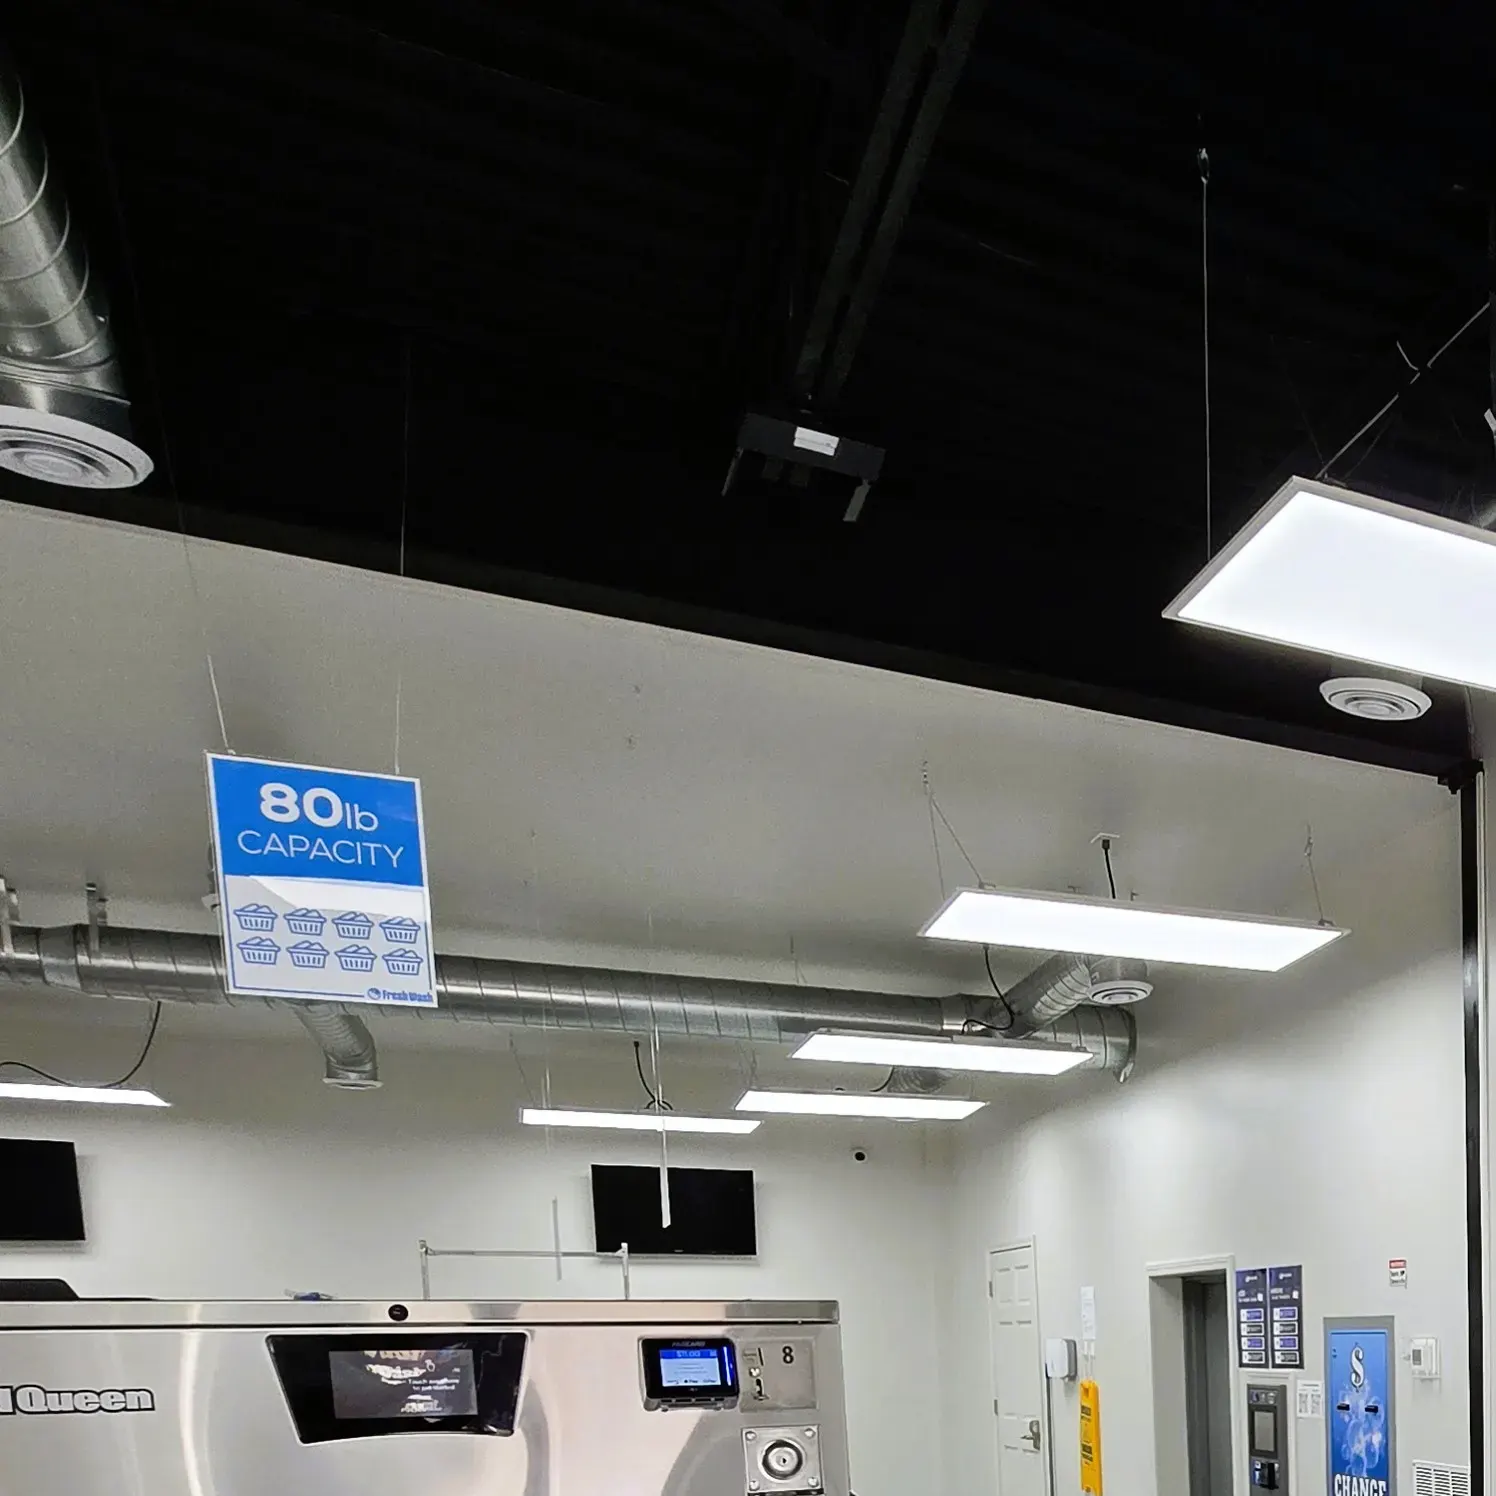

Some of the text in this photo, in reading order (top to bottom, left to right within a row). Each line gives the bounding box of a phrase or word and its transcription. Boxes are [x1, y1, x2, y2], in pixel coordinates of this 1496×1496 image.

[260, 783, 379, 832] 80lb
[237, 830, 404, 868] CAPACITY
[782, 1346, 794, 1364] 8
[15, 1384, 155, 1414] Queen
